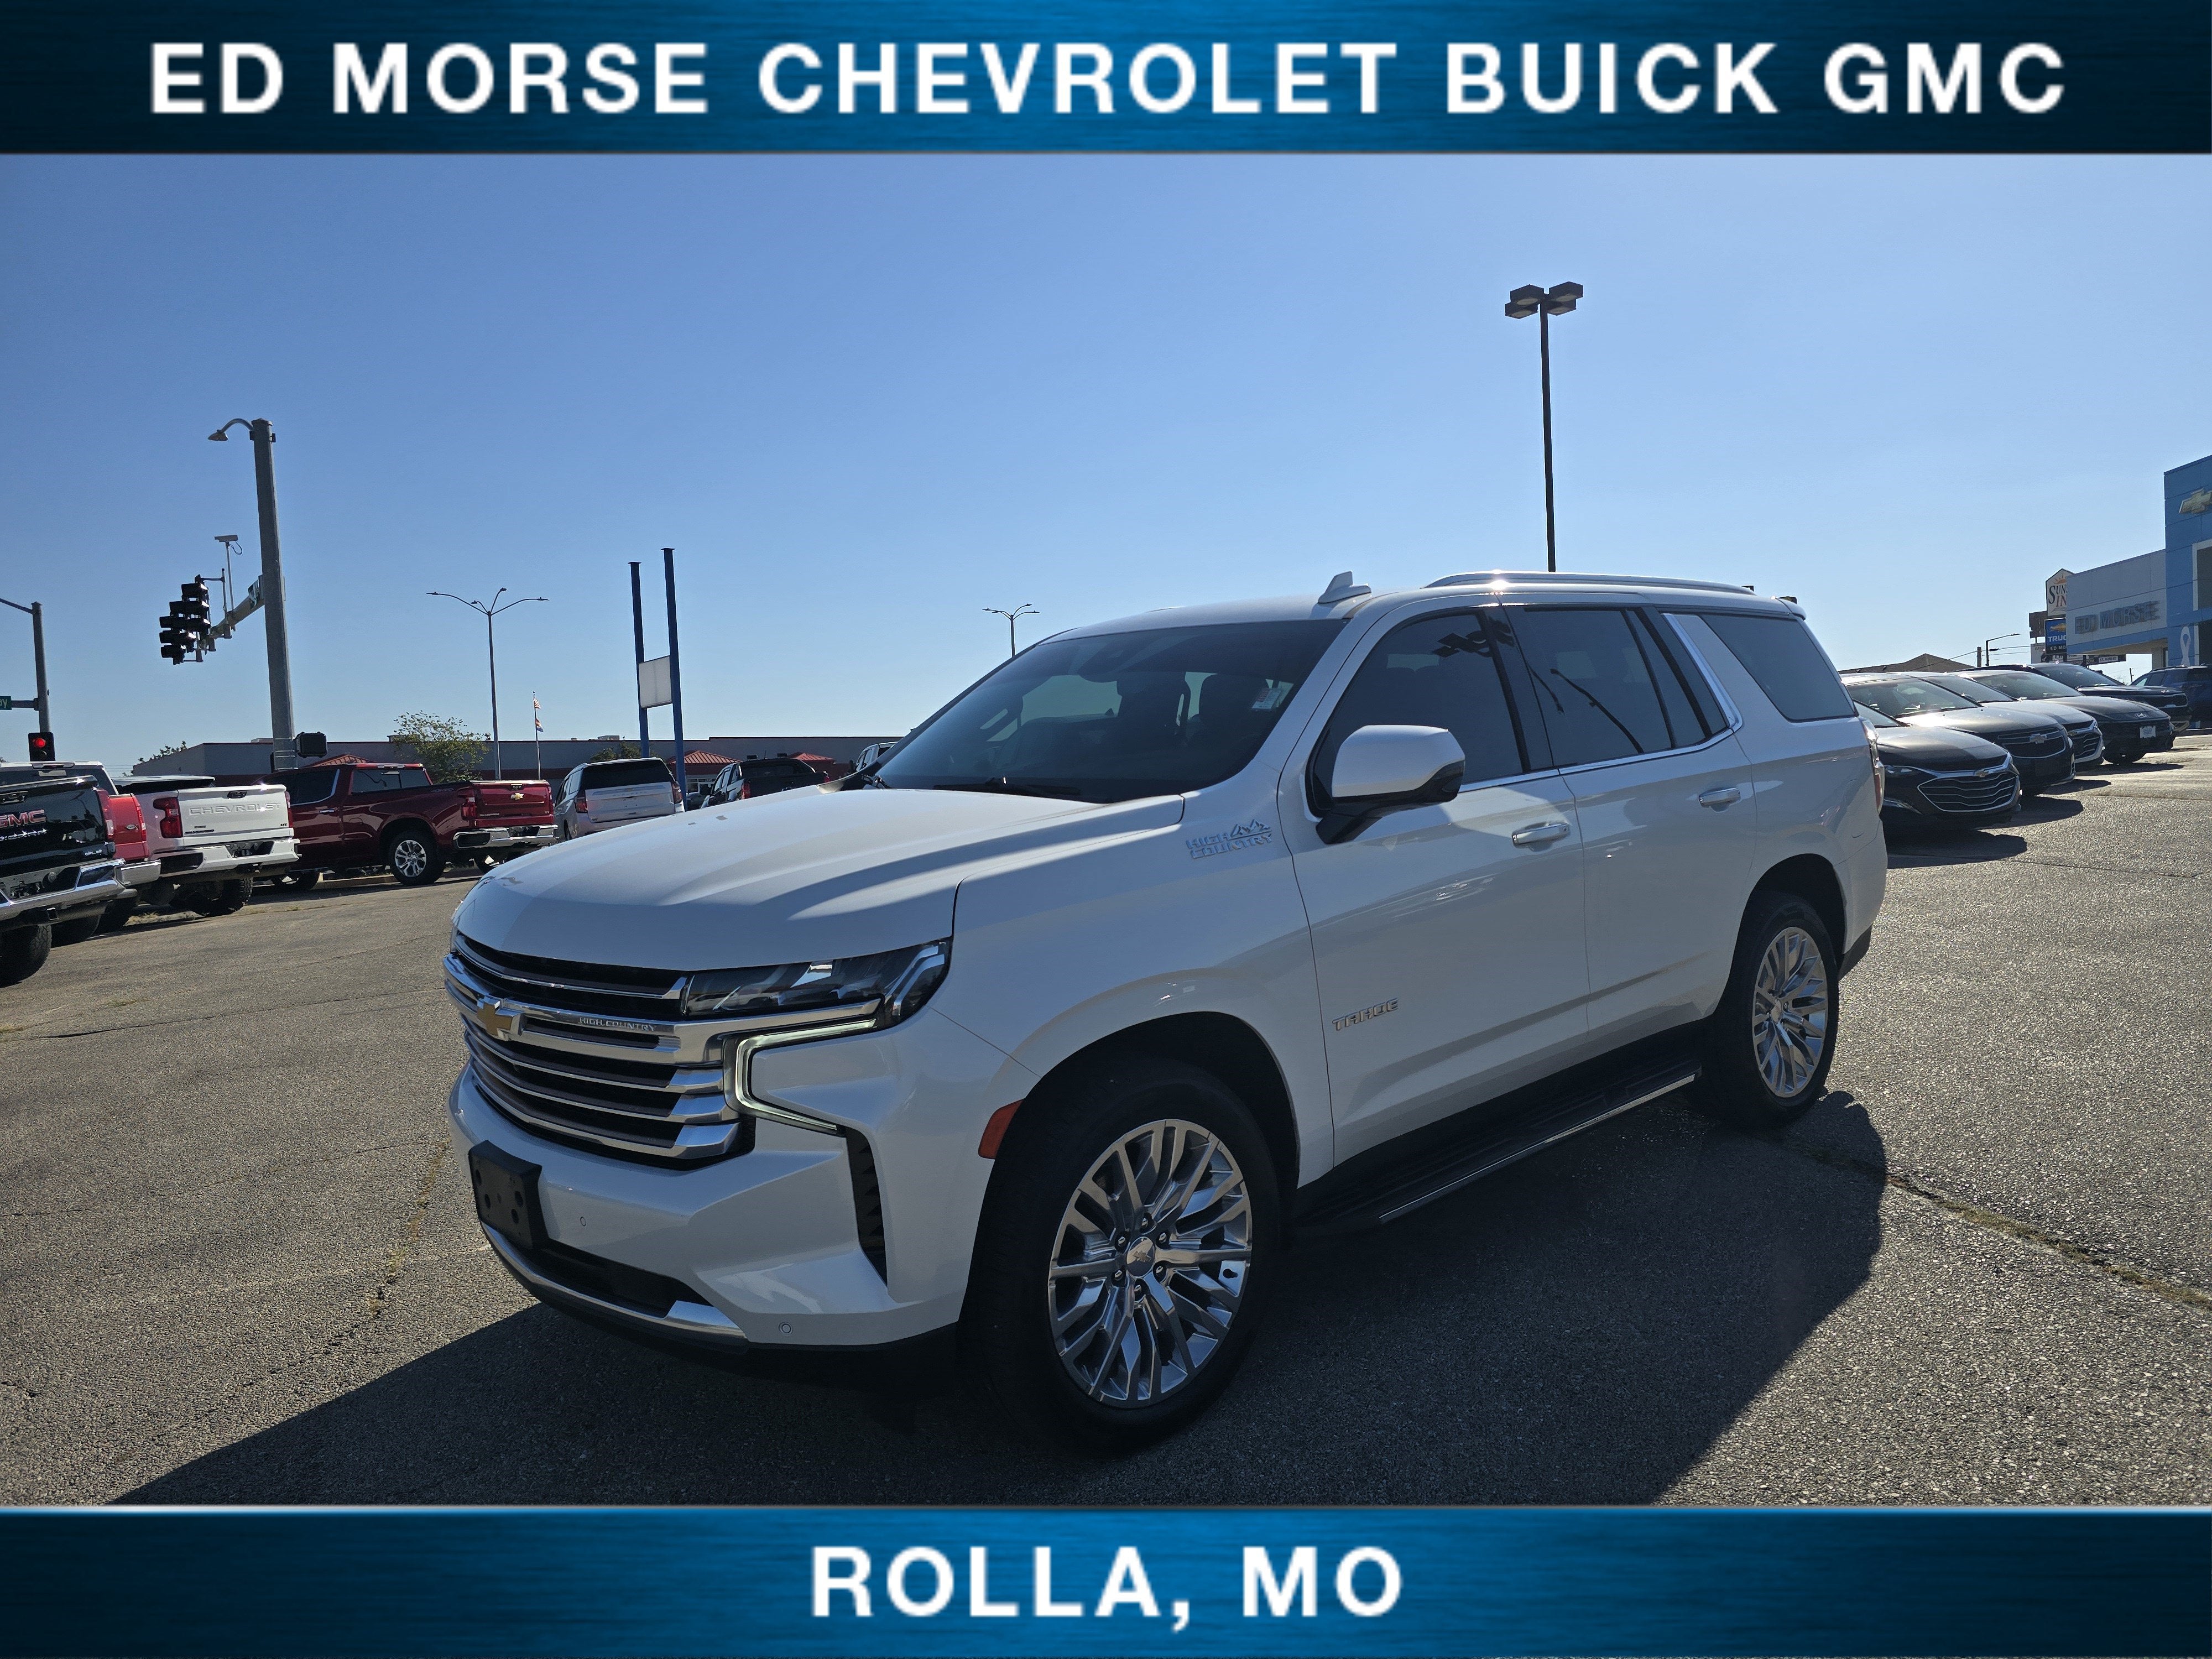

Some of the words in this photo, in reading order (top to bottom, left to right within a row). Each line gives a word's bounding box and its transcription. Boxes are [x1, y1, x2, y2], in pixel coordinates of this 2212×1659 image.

[2075, 615, 2097, 634] ED
[2100, 601, 2160, 629] MORSE
[189, 802, 281, 816] CHEVROLET
[1186, 832, 1233, 849] HIGH
[1190, 833, 1272, 859] COUNTRY
[579, 1017, 603, 1026] HIGH
[606, 1020, 657, 1032] COUNTRY
[1332, 998, 1399, 1031] TAHOE
